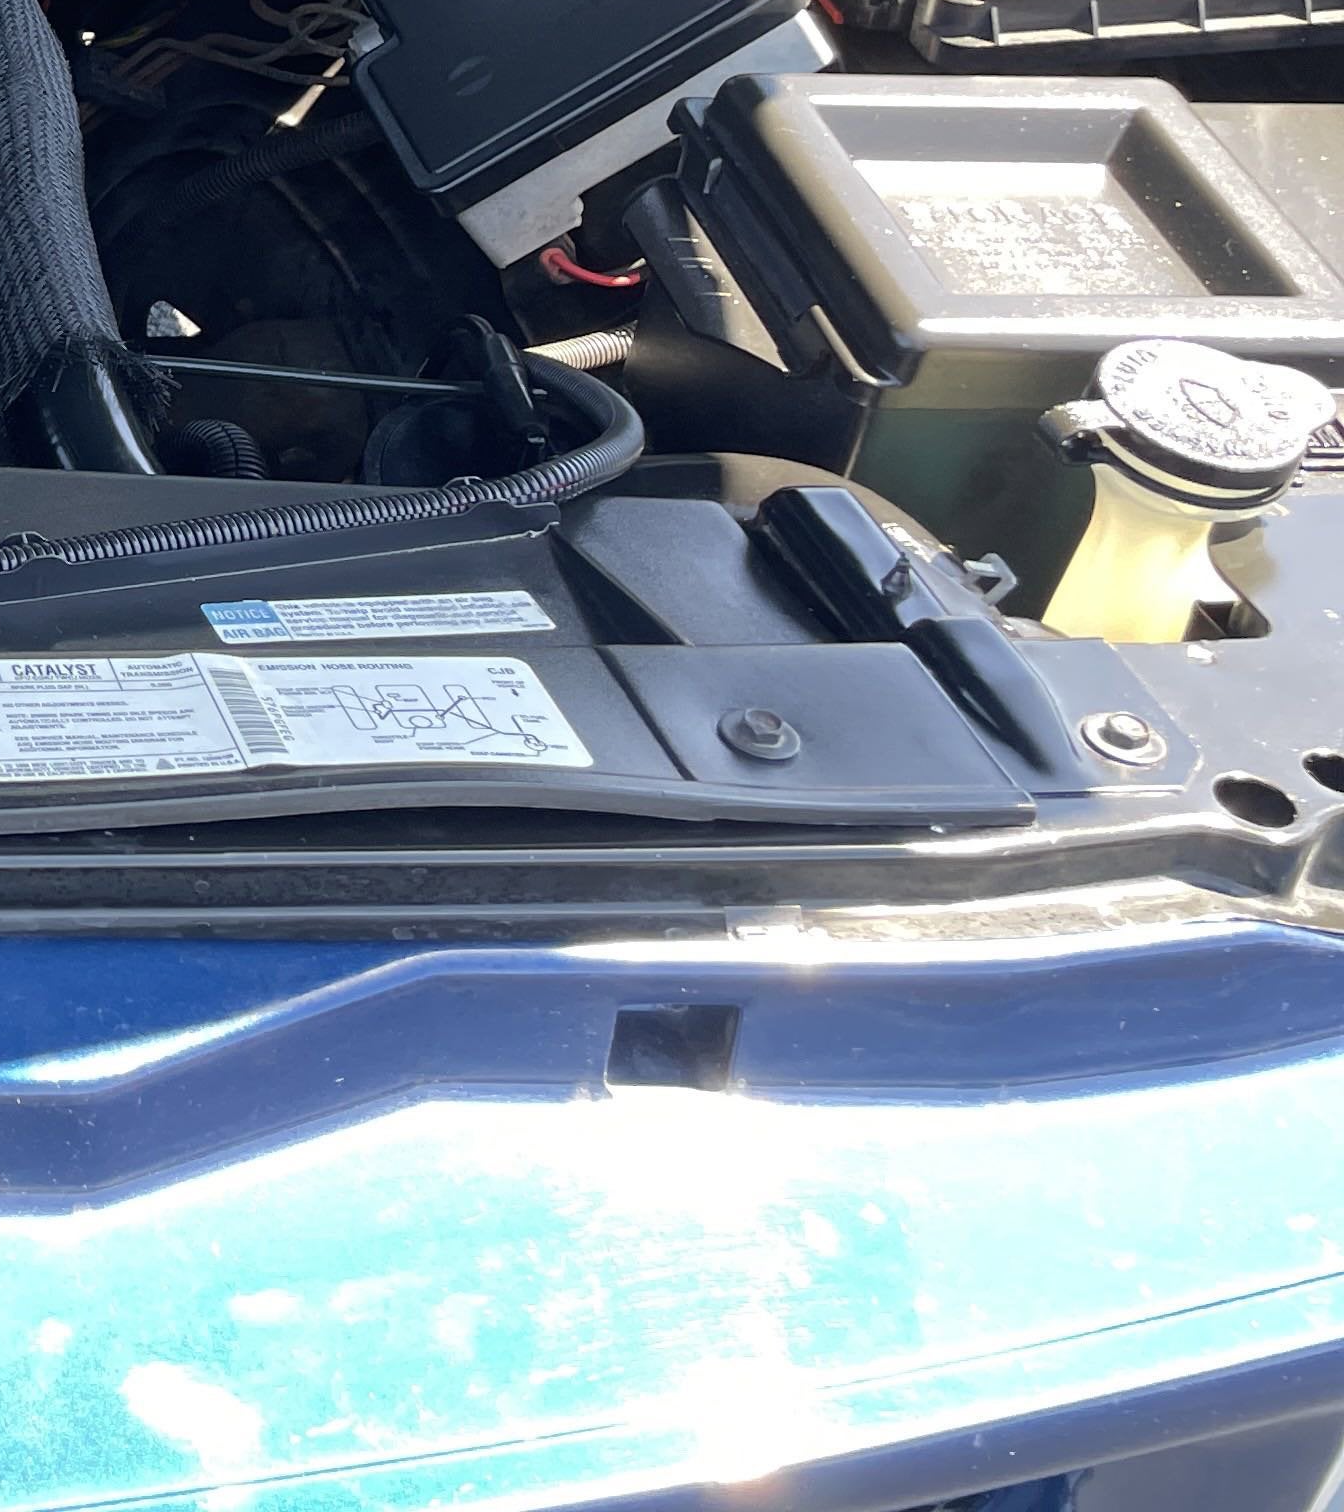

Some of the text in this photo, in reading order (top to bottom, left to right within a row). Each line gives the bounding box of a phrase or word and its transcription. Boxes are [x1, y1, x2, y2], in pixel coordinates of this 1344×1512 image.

[213, 608, 270, 621] NOTICE
[222, 628, 251, 639] AIR
[254, 626, 287, 638] BAG
[11, 663, 96, 677] CATALYST
[120, 666, 194, 678] TRANSMISSION
[127, 661, 183, 671] AUTOMATIC
[258, 662, 413, 672] EMISSION HOSE ROUTING
[487, 667, 515, 675] CJB
